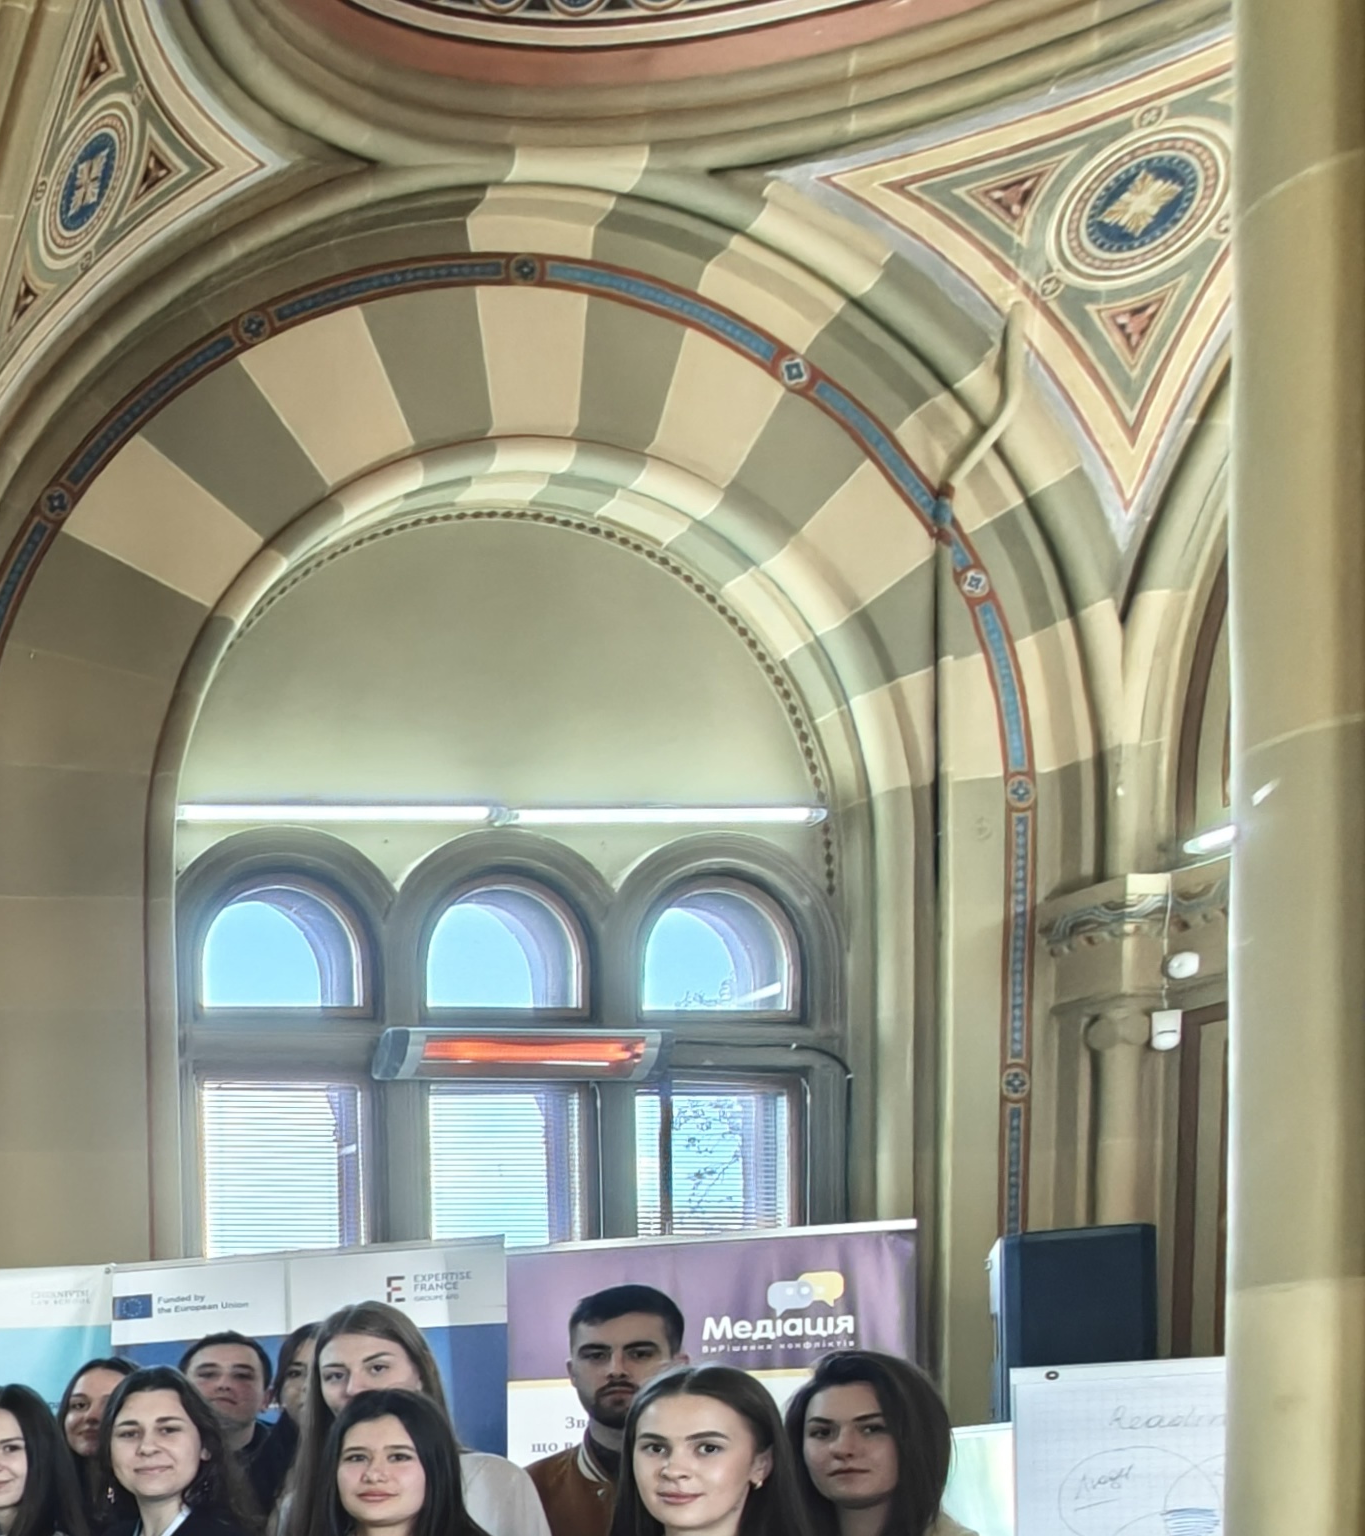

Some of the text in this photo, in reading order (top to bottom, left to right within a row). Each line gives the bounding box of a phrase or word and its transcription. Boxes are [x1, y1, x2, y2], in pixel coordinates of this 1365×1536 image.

[413, 1270, 473, 1283] EXPERTISE
[413, 1281, 460, 1292] FRANCE
[157, 1293, 206, 1304] Funded by
[157, 1301, 250, 1314] the European Union
[702, 1314, 855, 1341] Медіація
